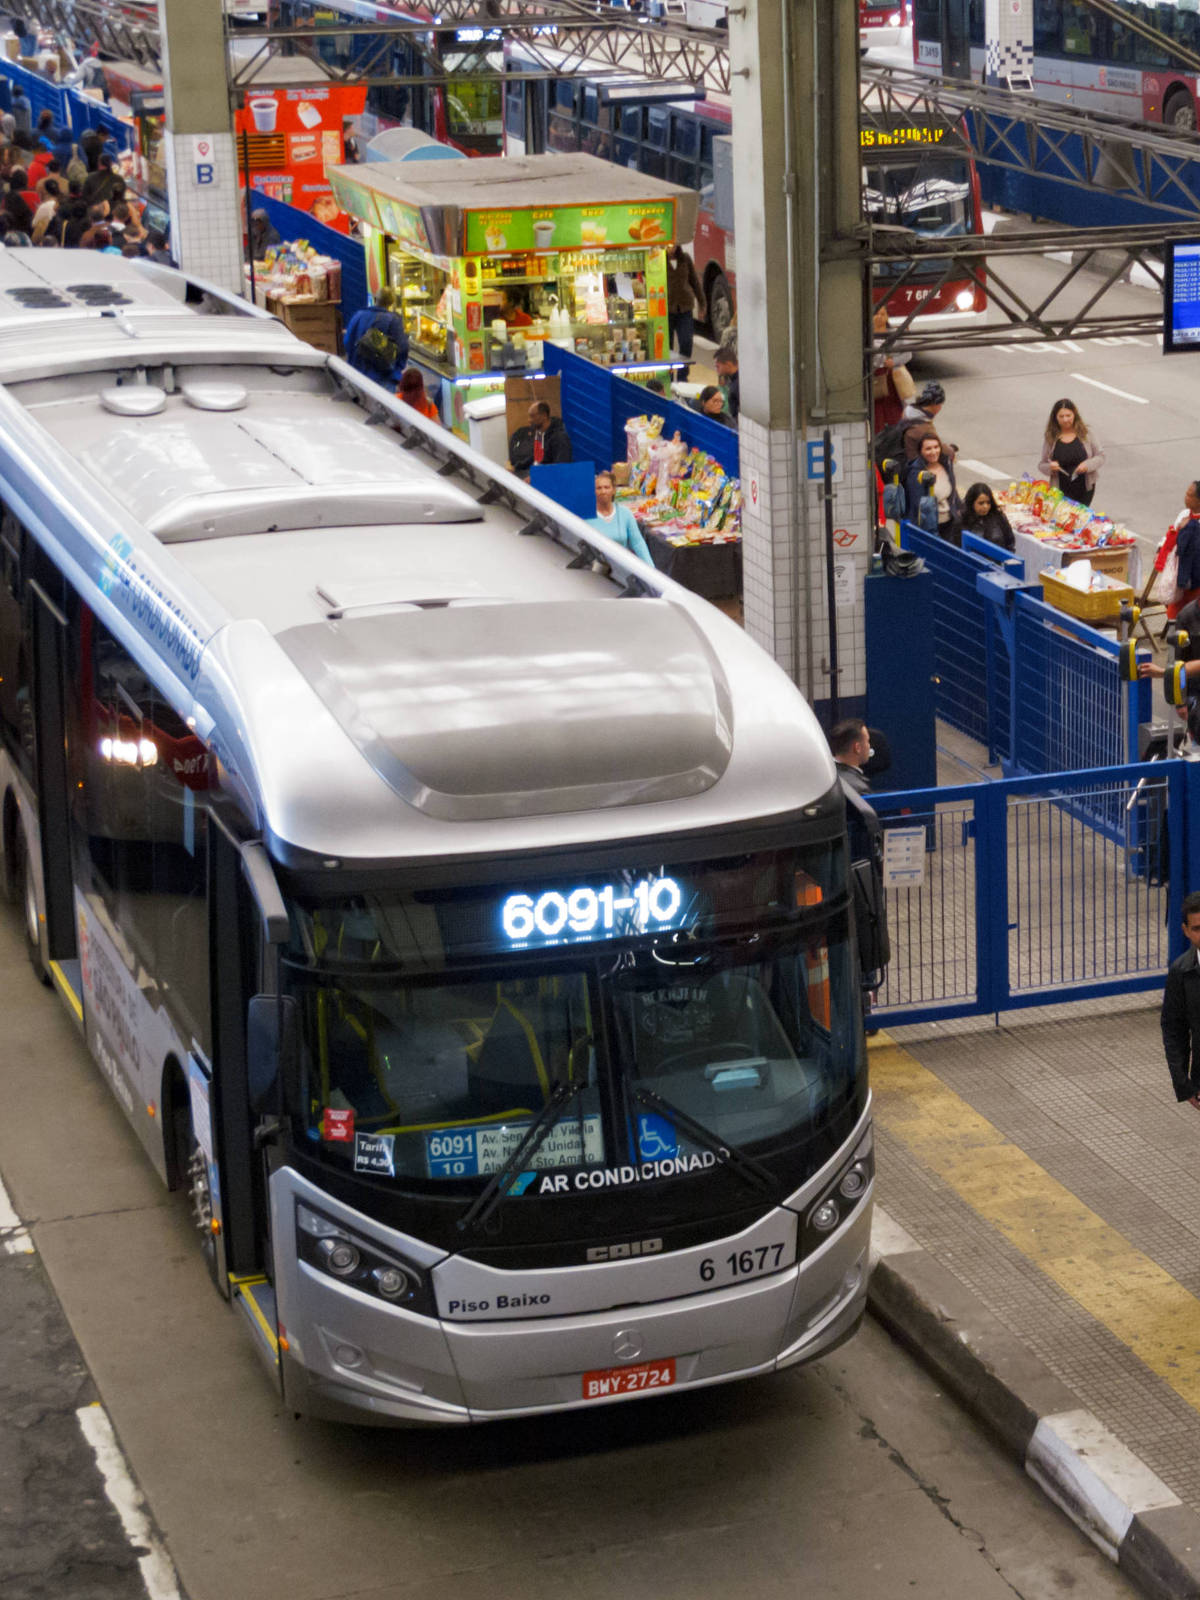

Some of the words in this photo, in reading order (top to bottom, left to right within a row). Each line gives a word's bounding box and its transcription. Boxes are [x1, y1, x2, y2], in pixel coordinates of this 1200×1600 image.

[196, 163, 214, 184] B
[906, 290, 913, 301] 7
[806, 440, 837, 479] B
[503, 878, 681, 939] 6091-10
[430, 1135, 473, 1157] 6091
[482, 1133, 498, 1145] Av.
[482, 1147, 498, 1159] Av.
[442, 1162, 465, 1175] 10
[536, 1157, 555, 1168] Sto
[539, 1175, 570, 1194] AR
[574, 1147, 730, 1190] CONDICIONADO
[586, 1237, 664, 1262] CAIO
[699, 1259, 715, 1282] 6
[726, 1243, 785, 1276] 1677
[448, 1299, 490, 1314] Piso
[496, 1292, 551, 1309] Baixo
